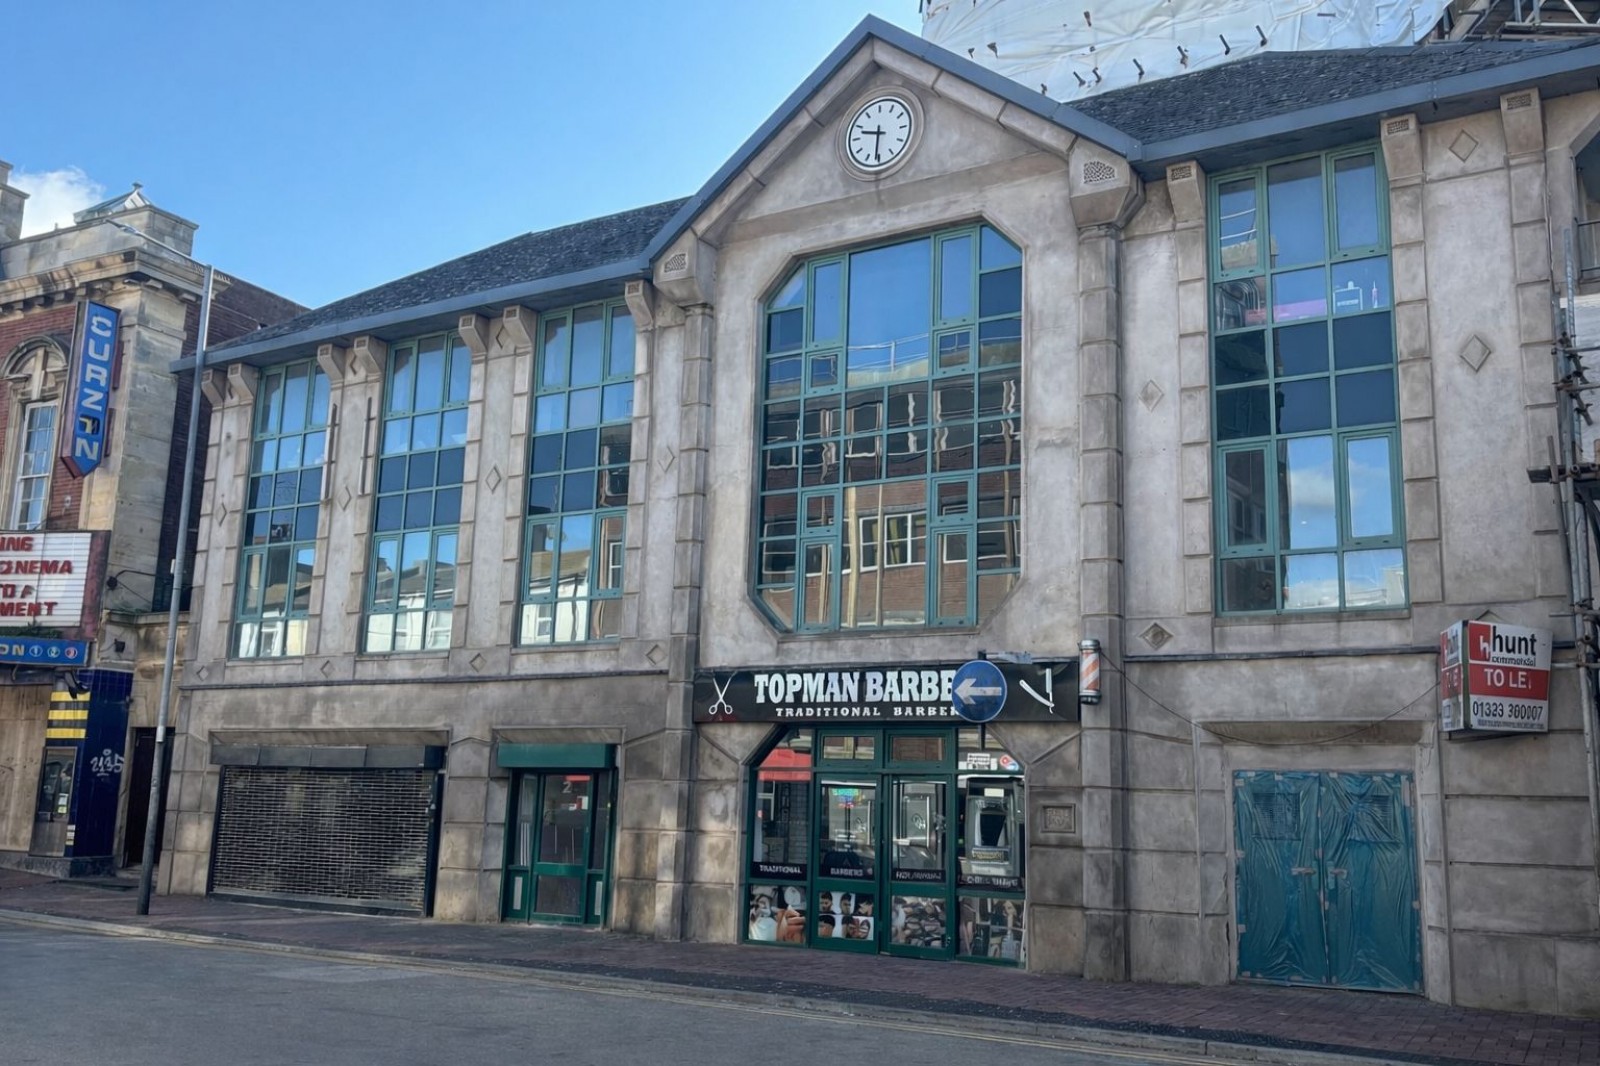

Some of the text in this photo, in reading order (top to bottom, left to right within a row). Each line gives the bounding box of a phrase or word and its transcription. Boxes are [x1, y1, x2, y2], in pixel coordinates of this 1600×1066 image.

[1492, 625, 1537, 656] hunt
[1484, 668, 1505, 687] TO
[754, 671, 860, 704] TOPMAN
[776, 706, 881, 717] TRADITIONAL
[562, 781, 572, 794] 2
